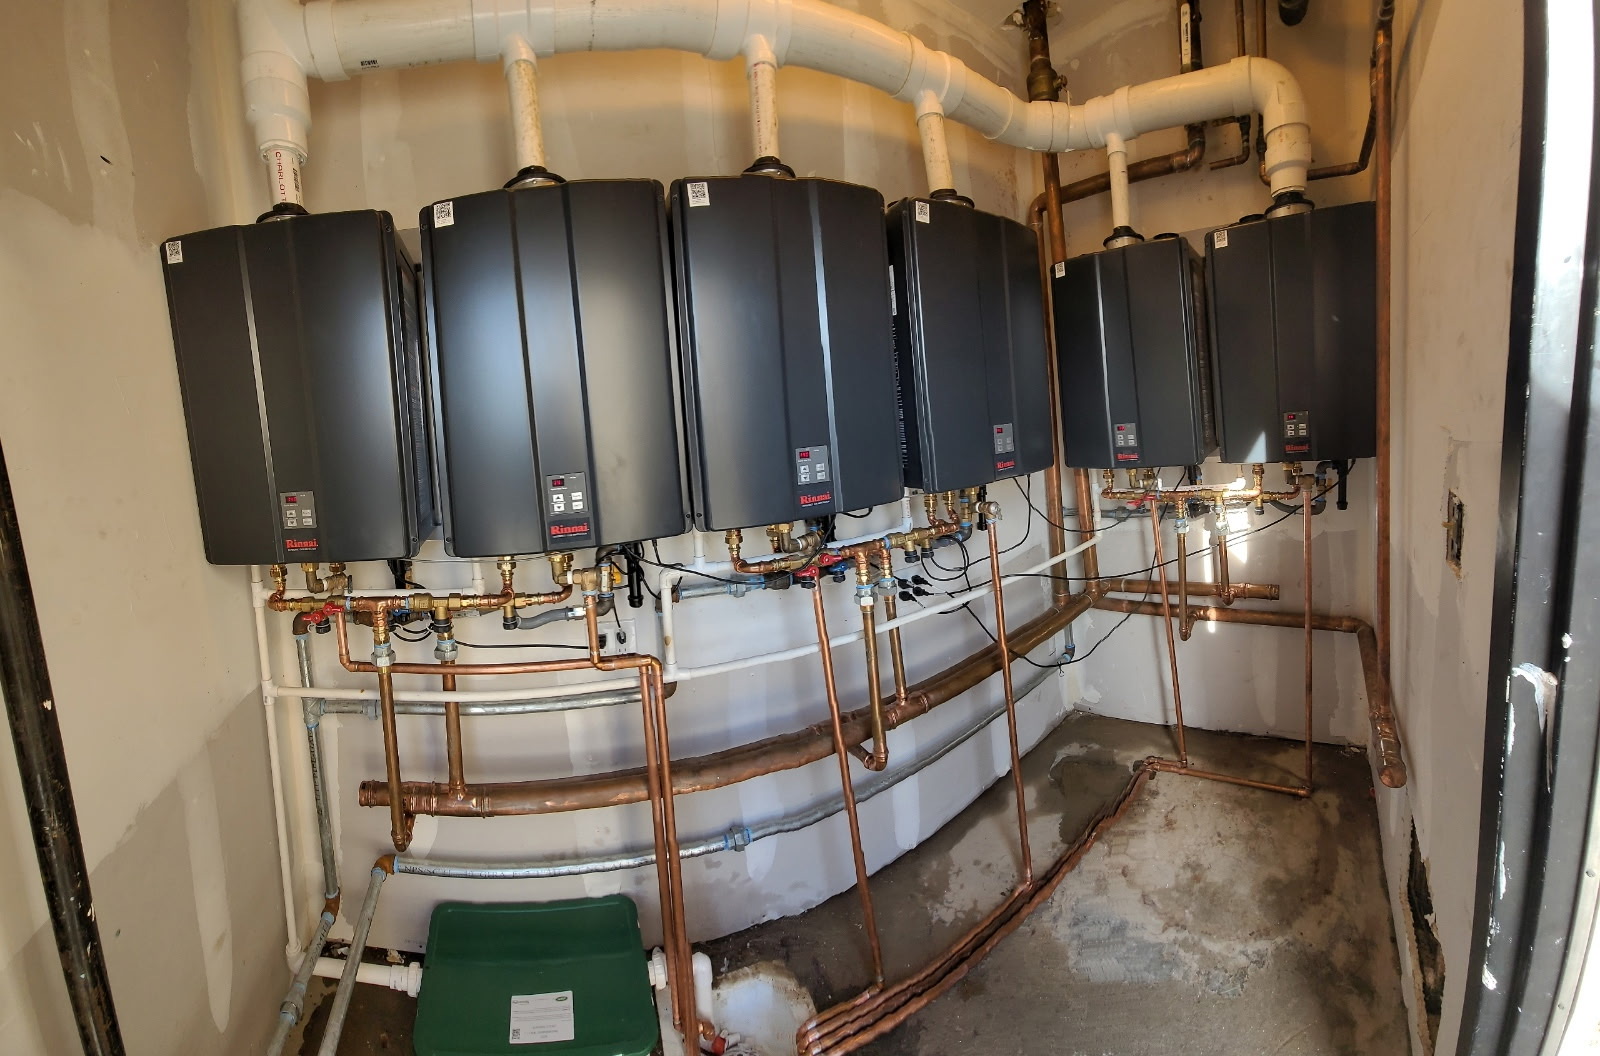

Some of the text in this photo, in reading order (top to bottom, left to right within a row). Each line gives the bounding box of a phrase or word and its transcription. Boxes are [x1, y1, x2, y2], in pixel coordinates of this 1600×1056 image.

[275, 151, 287, 202] CHARLOTT
[800, 491, 831, 505] Rinnai
[550, 522, 588, 535] Rinnai
[285, 538, 317, 549] Rinnai
